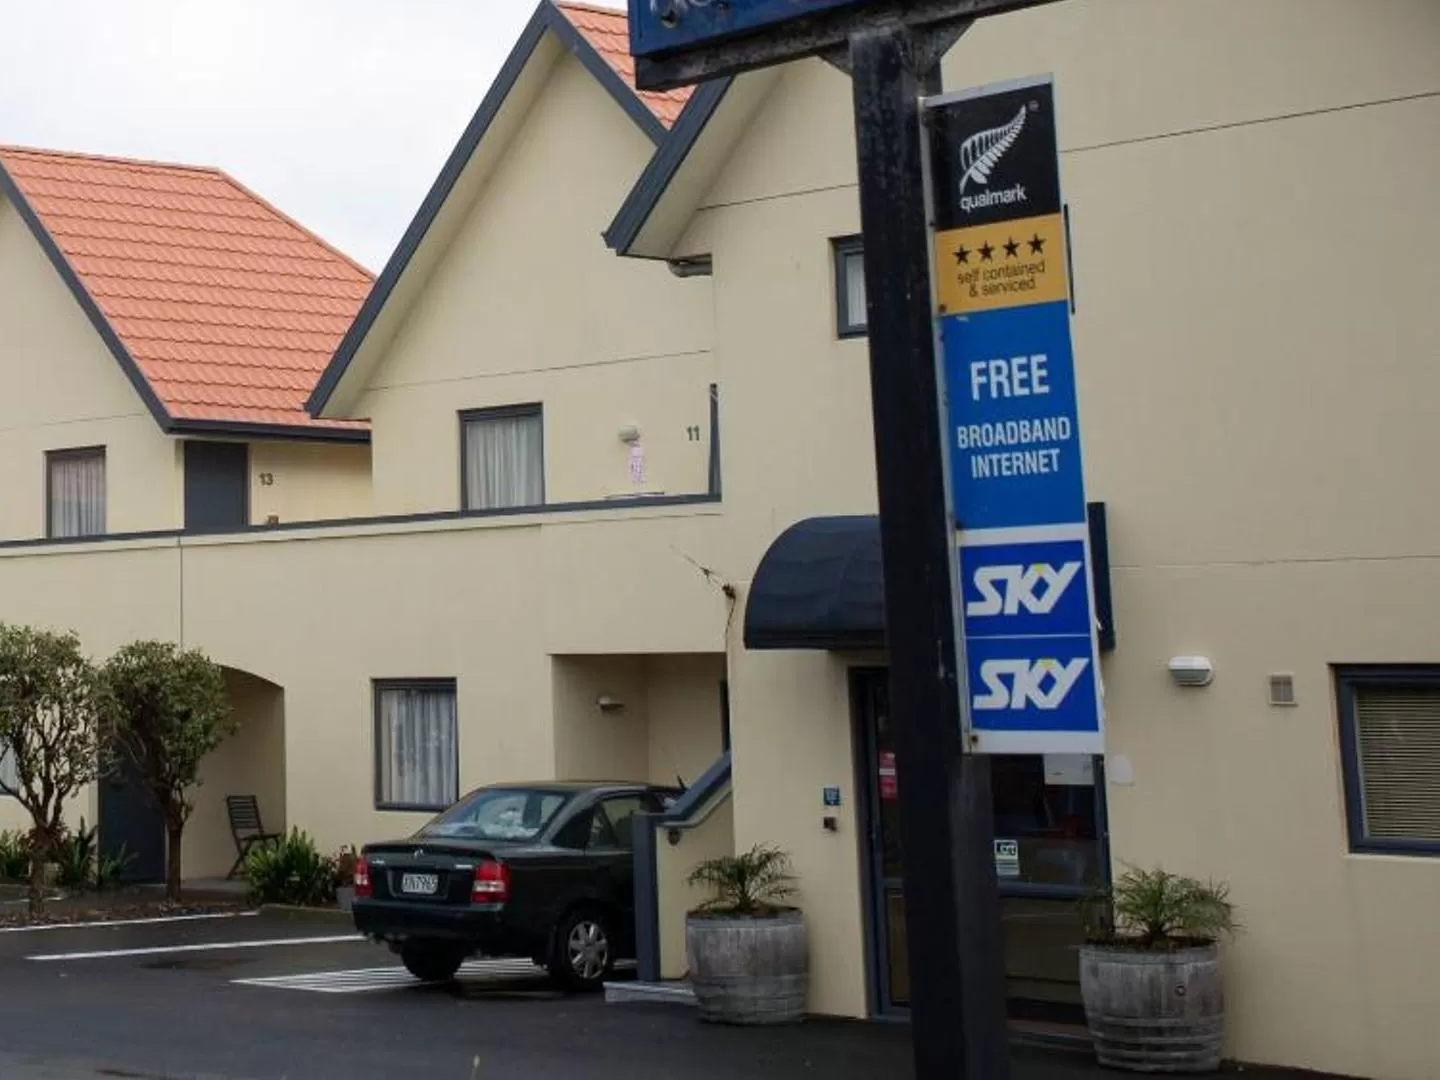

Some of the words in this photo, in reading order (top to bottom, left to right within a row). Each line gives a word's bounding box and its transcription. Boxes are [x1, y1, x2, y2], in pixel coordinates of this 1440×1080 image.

[960, 183, 1027, 212] qualmark
[957, 267, 980, 284] self
[983, 260, 1046, 280] contained
[968, 283, 979, 298] &
[982, 277, 1037, 295] serviced
[970, 354, 1050, 400] FREE
[686, 424, 700, 441] 11
[957, 416, 1071, 449] BROADBAND
[971, 448, 1060, 479] INTERNET
[259, 472, 274, 486] 13
[966, 561, 1083, 616] SKY
[973, 658, 1090, 710] SKY
